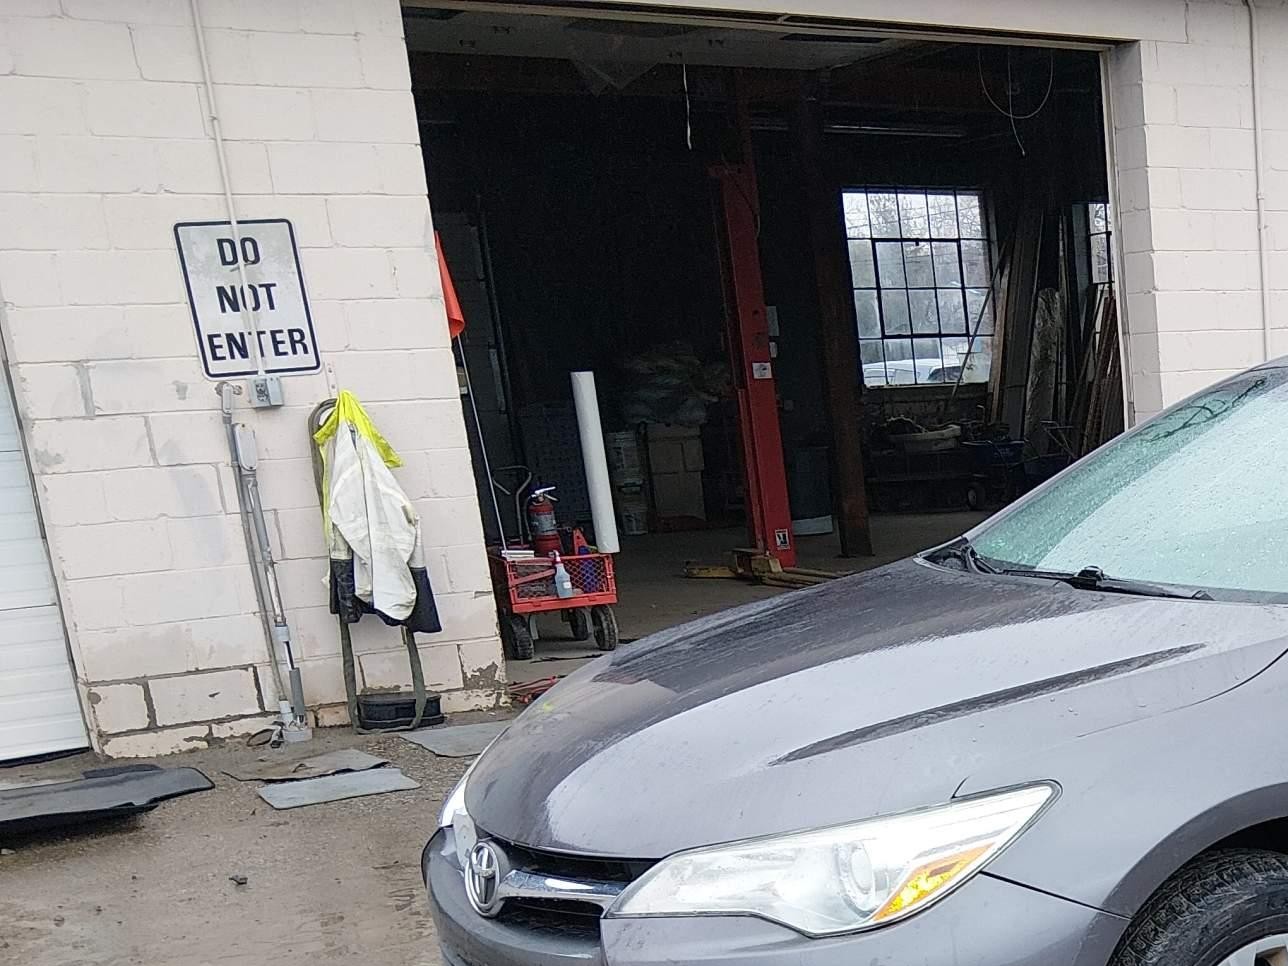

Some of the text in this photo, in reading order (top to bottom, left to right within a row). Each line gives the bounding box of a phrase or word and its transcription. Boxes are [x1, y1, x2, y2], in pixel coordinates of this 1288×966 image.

[216, 237, 260, 266] DO
[216, 283, 276, 314] NOT
[207, 328, 309, 361] ENTER
